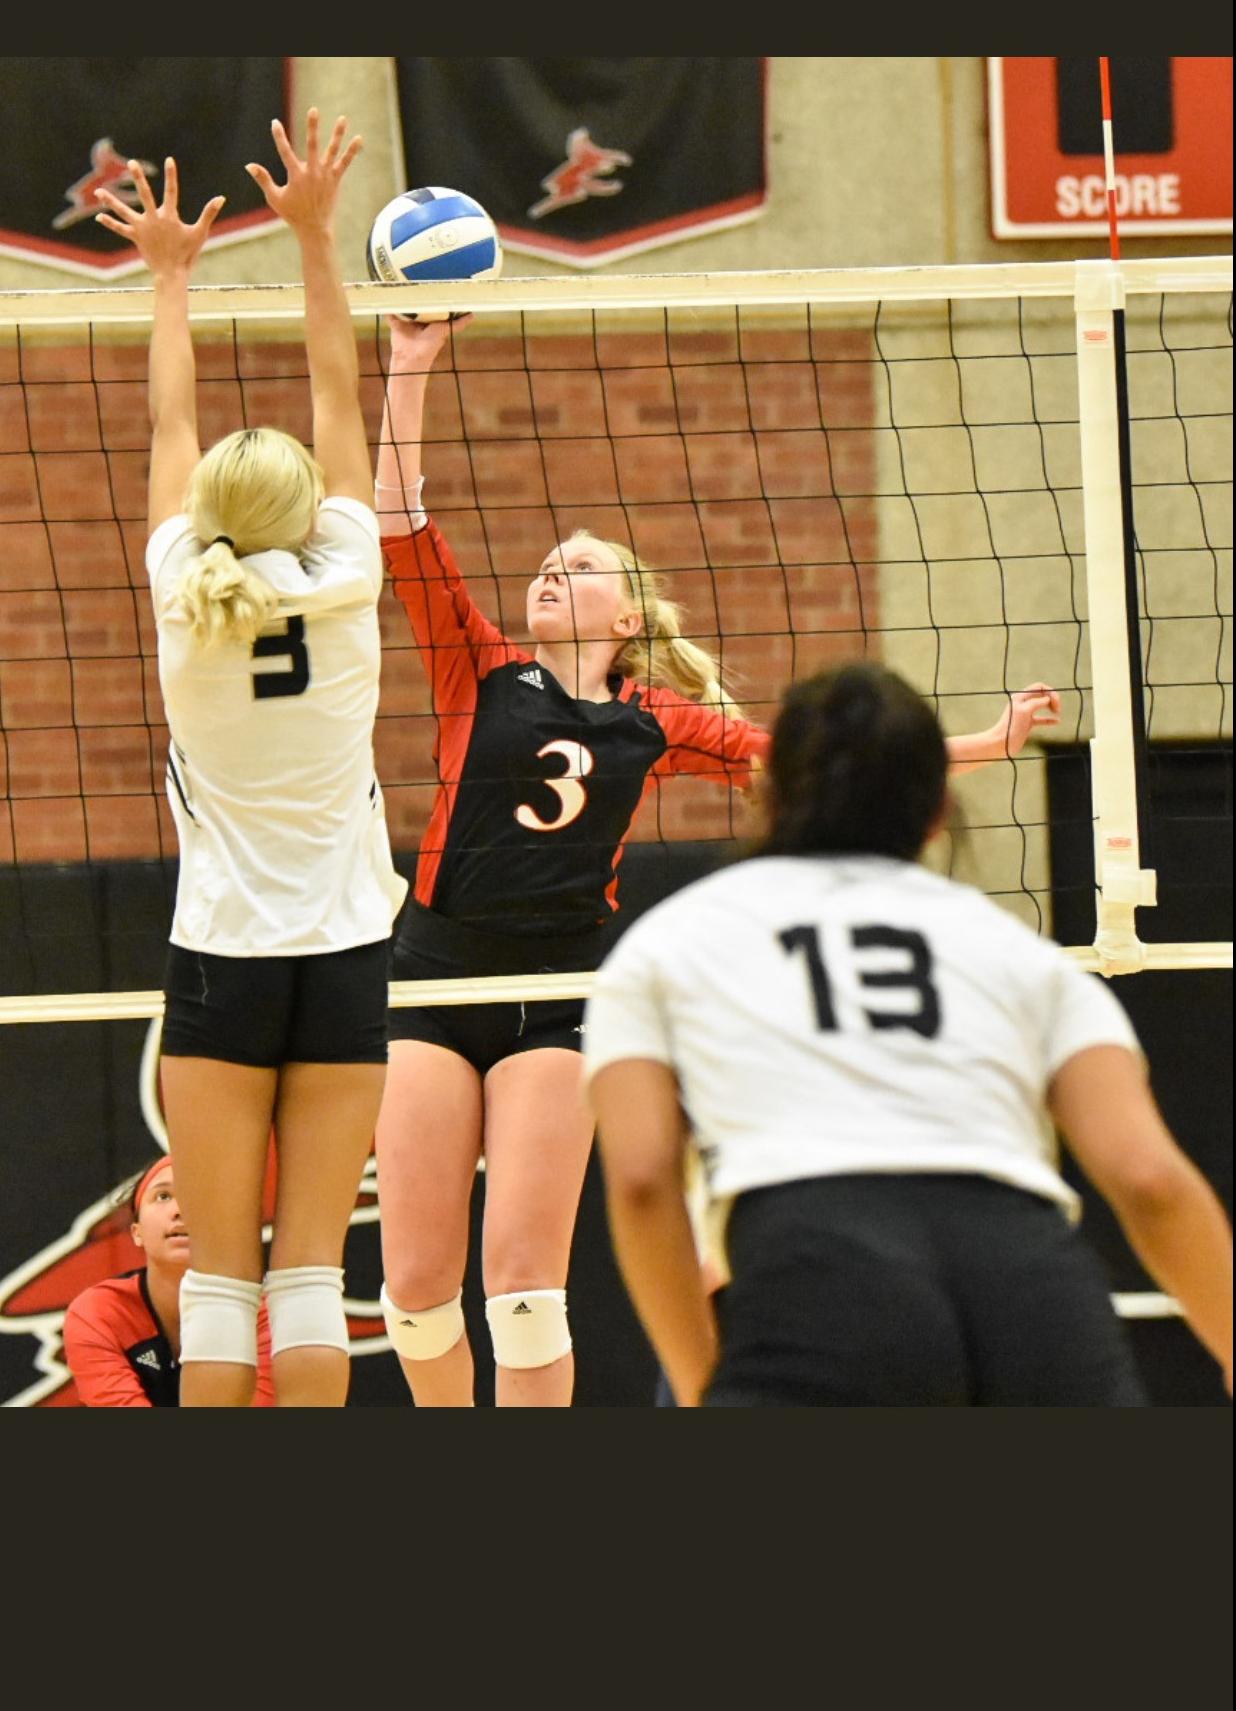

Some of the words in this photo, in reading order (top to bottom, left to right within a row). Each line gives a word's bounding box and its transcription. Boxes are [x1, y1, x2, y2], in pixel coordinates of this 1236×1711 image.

[1056, 174, 1181, 217] SCORE
[252, 614, 309, 699] 3
[514, 739, 594, 832] 3
[776, 923, 942, 1039] 13
